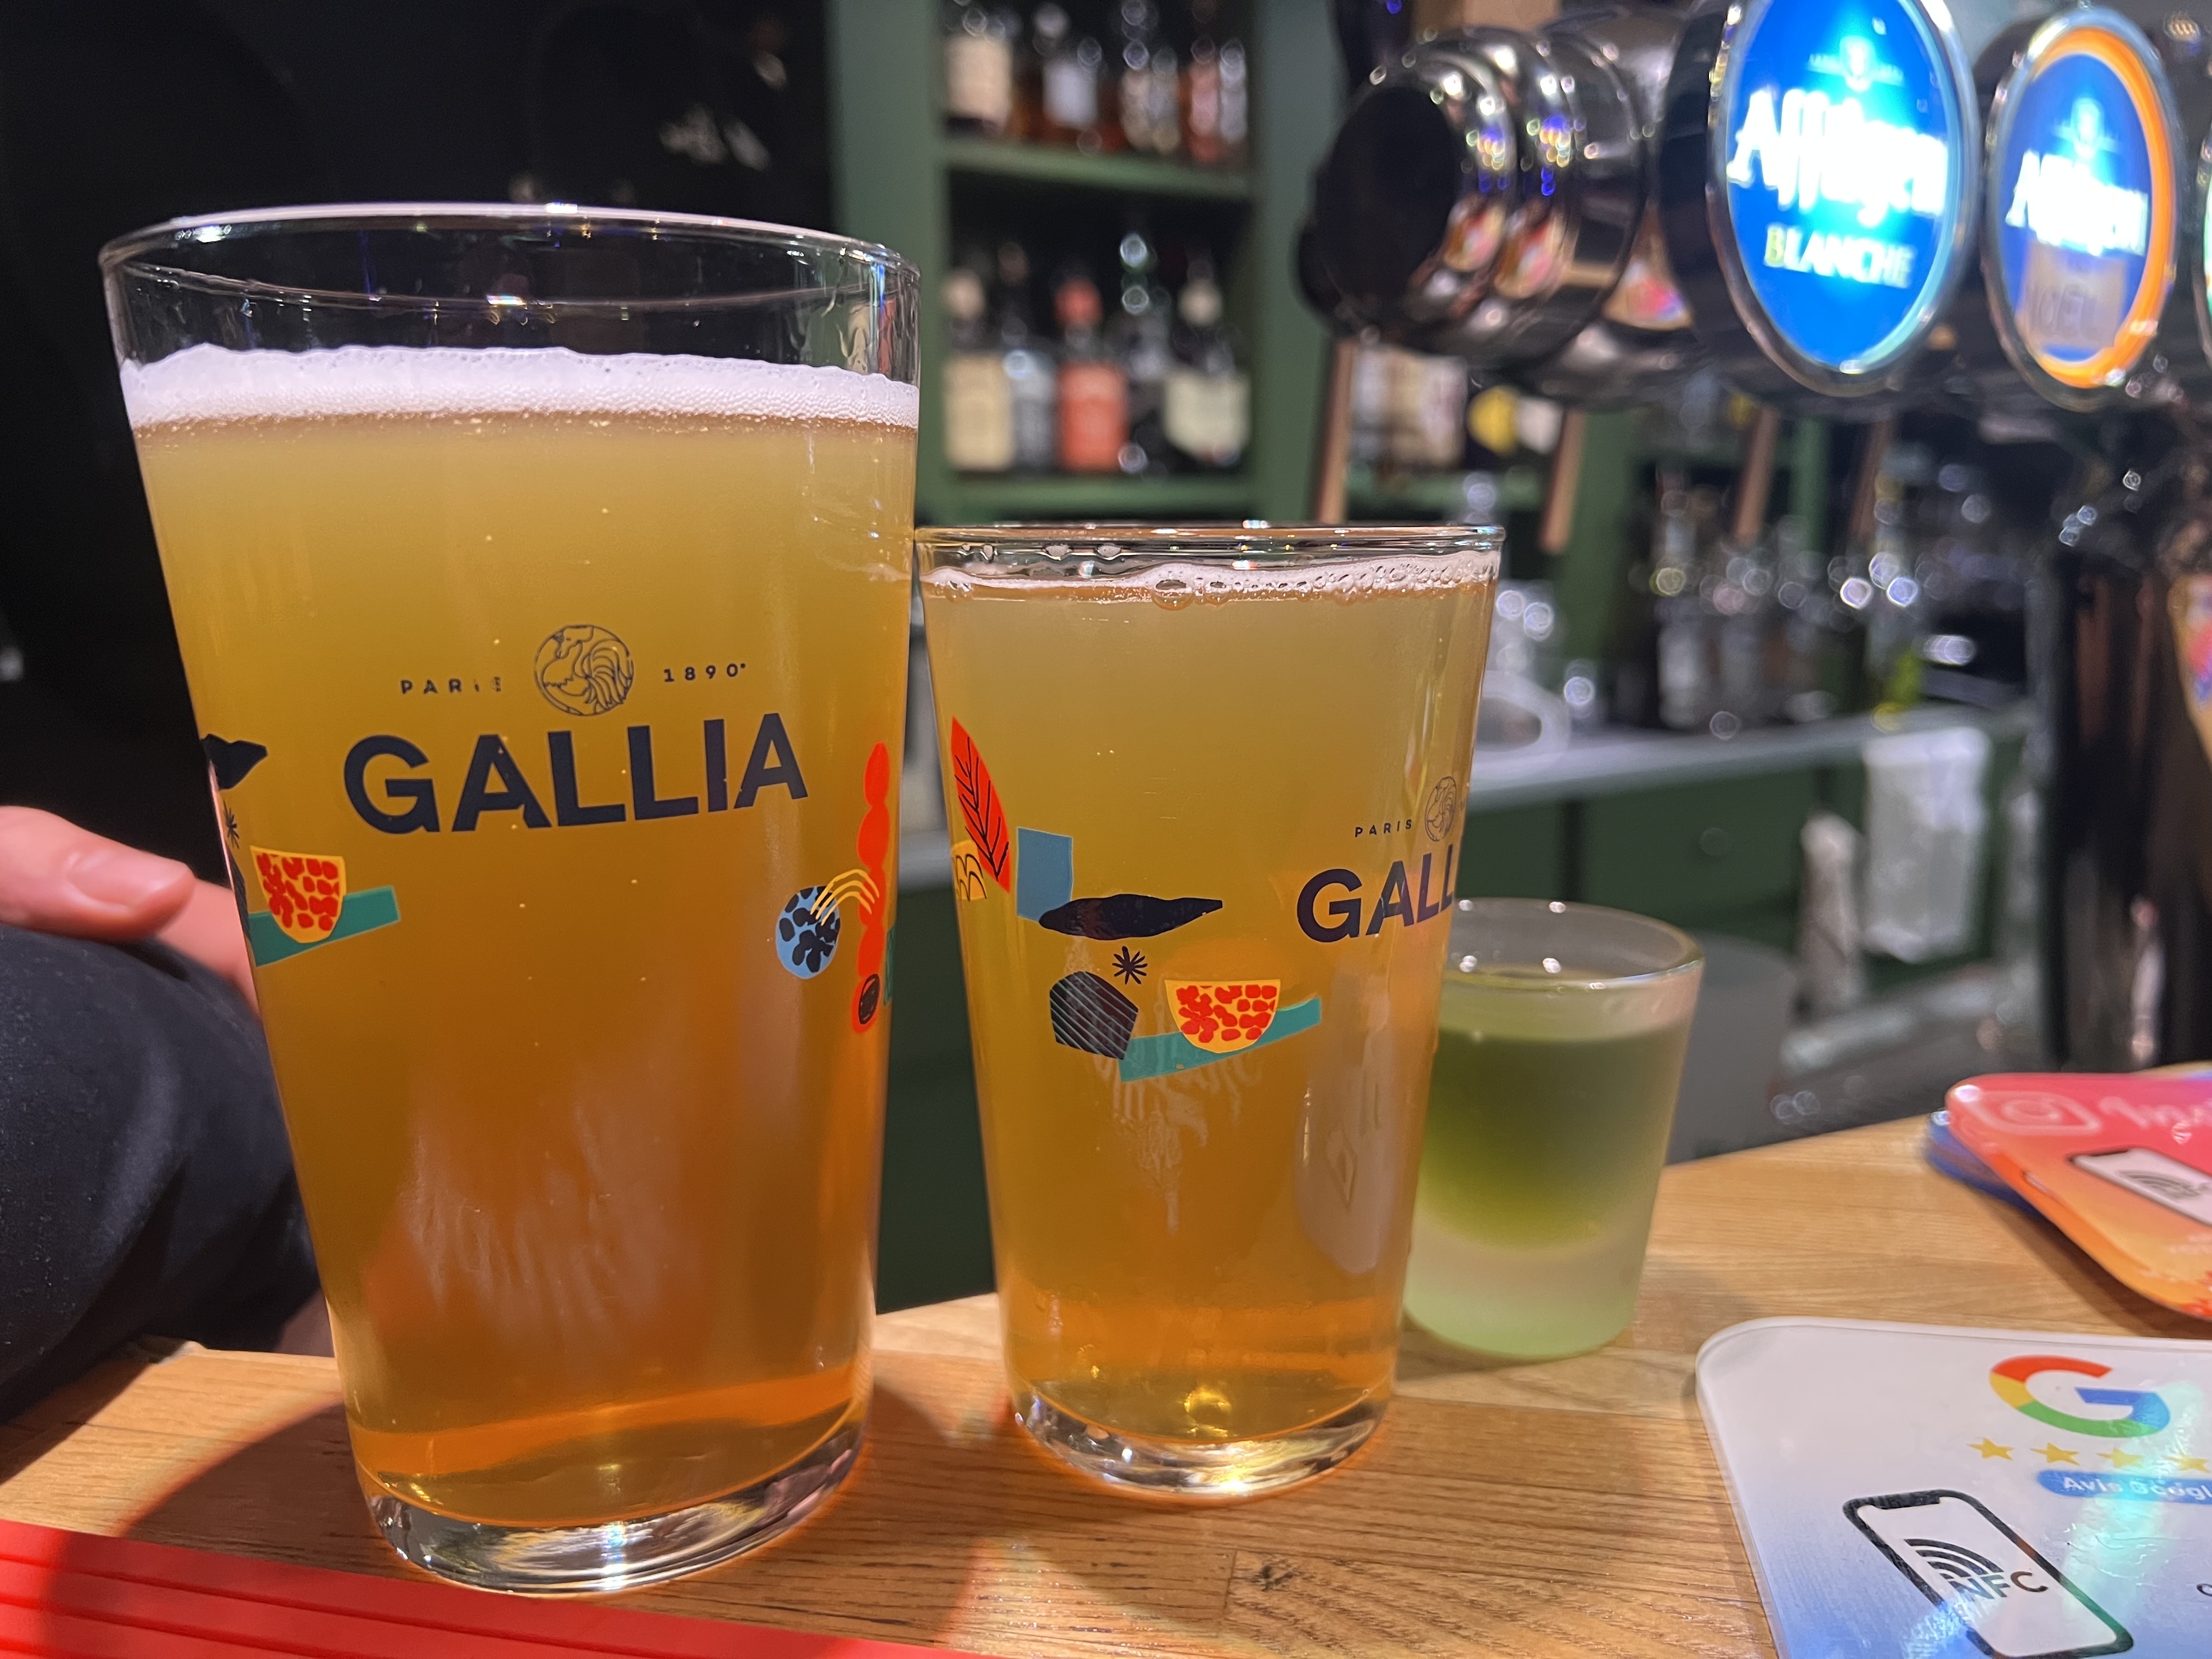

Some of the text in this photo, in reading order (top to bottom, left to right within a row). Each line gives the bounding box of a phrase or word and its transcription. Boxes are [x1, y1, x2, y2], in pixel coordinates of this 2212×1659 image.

[1764, 225, 1916, 288] BLANCHE
[343, 712, 809, 834] GALLIA
[1355, 819, 1413, 838] PARIS
[1296, 843, 1454, 943] GALL
